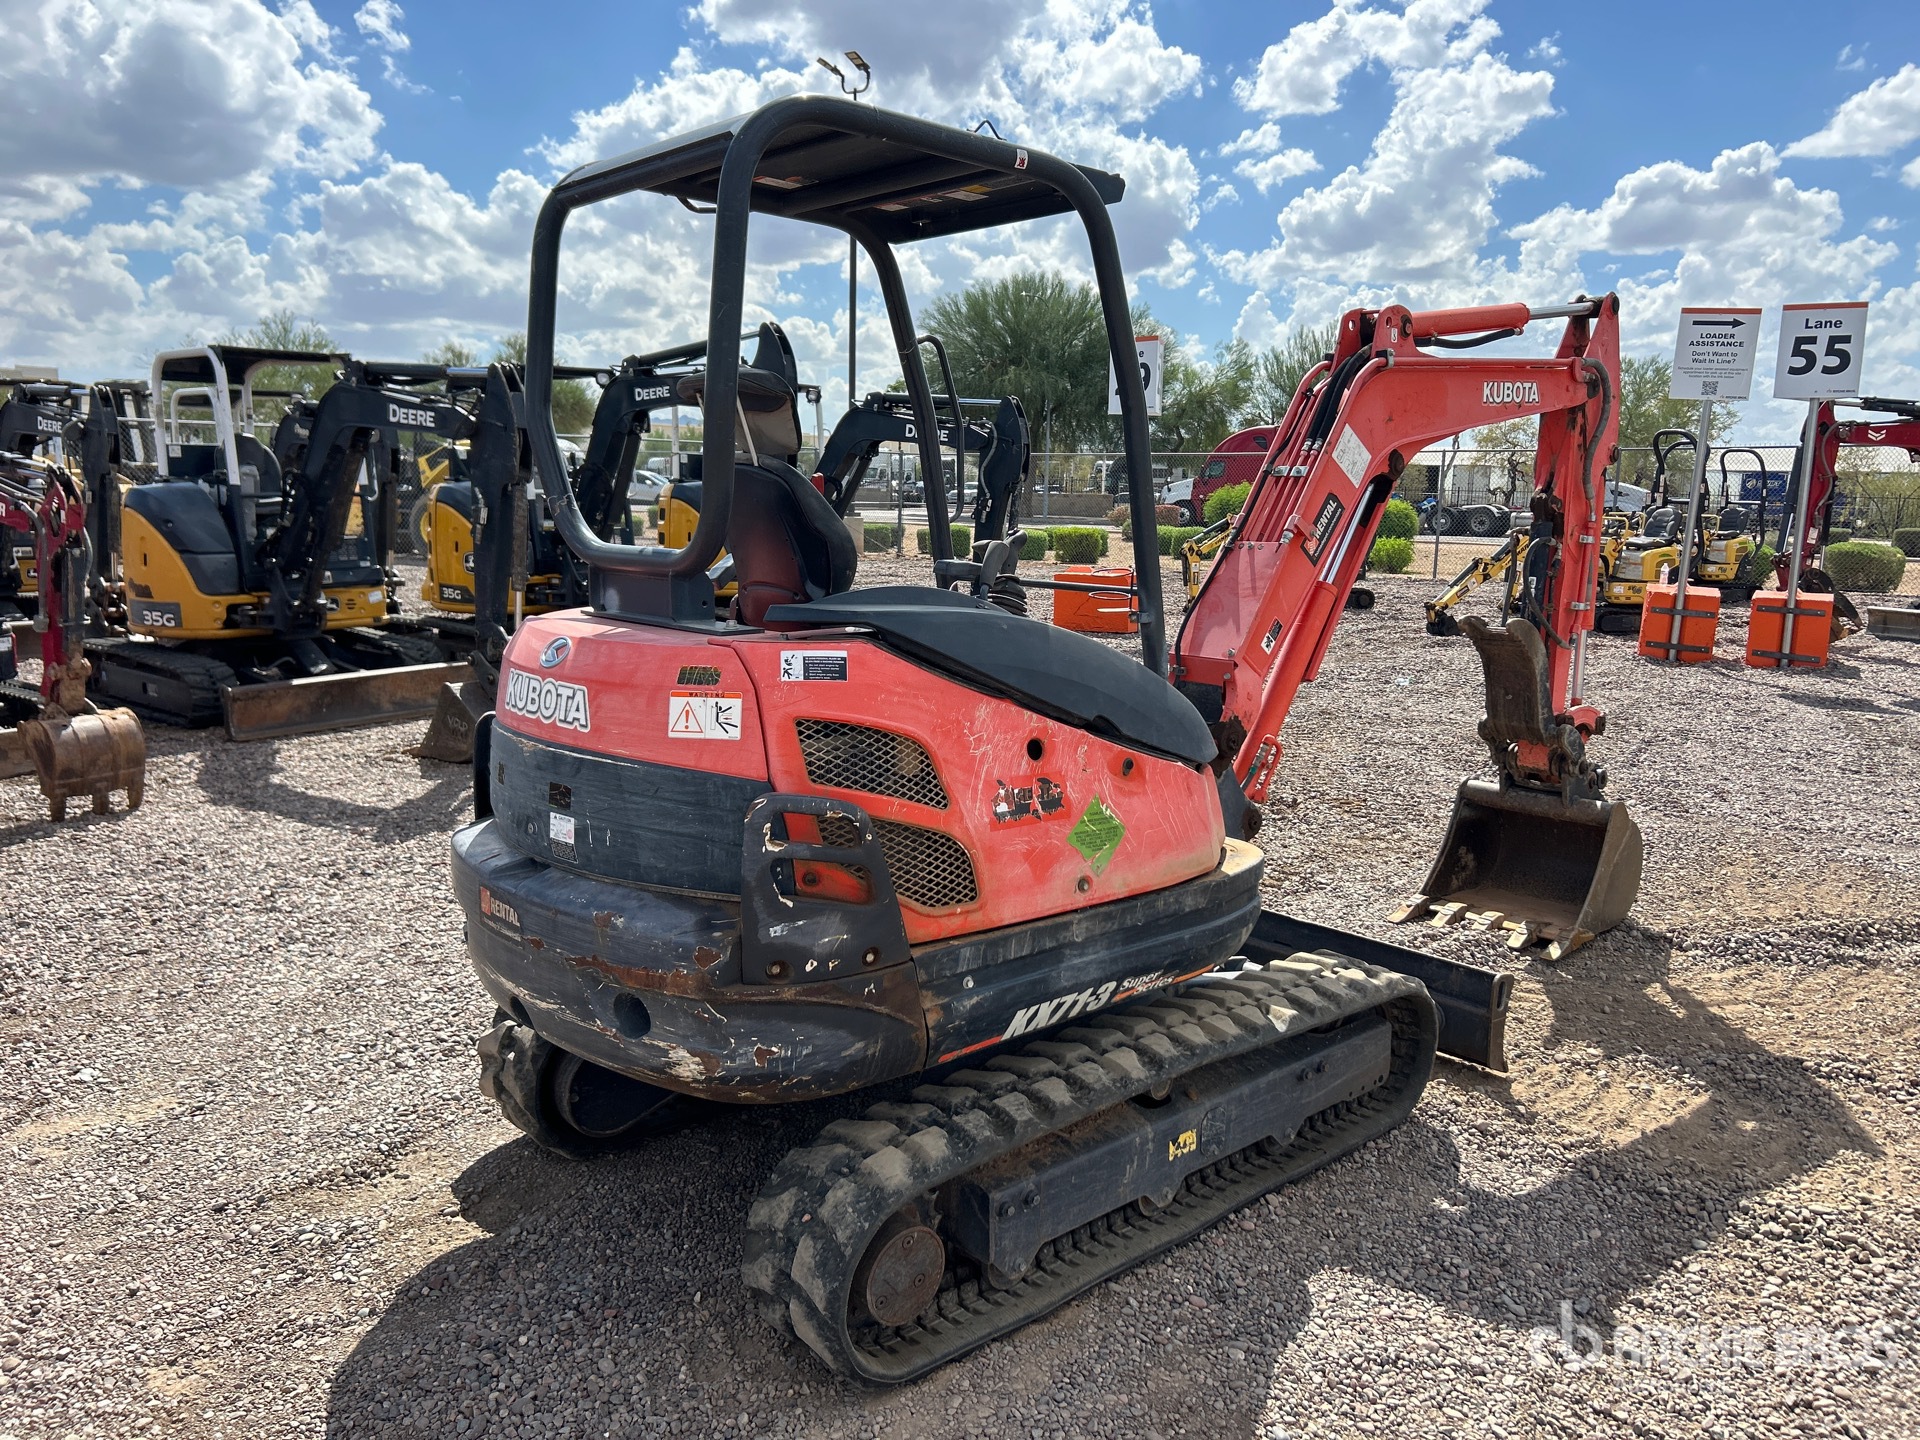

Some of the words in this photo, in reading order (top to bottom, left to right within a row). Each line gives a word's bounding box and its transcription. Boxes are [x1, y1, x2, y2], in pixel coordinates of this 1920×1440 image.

[1804, 317, 1844, 330] Lane
[1688, 340, 1745, 348] ASSISTANCE
[1700, 332, 1736, 340] LOADER
[1787, 334, 1852, 376] 55
[634, 385, 671, 402] DEERE
[1482, 381, 1540, 404] KUBOTA
[37, 415, 62, 433] DEERE
[389, 403, 436, 428] DEERE
[442, 587, 462, 600] 35G
[142, 610, 176, 627] 35G
[506, 669, 588, 731] KUBOTA
[1119, 968, 1165, 990] Super
[1133, 975, 1175, 995] Series
[1000, 980, 1117, 1042] KX71-3
